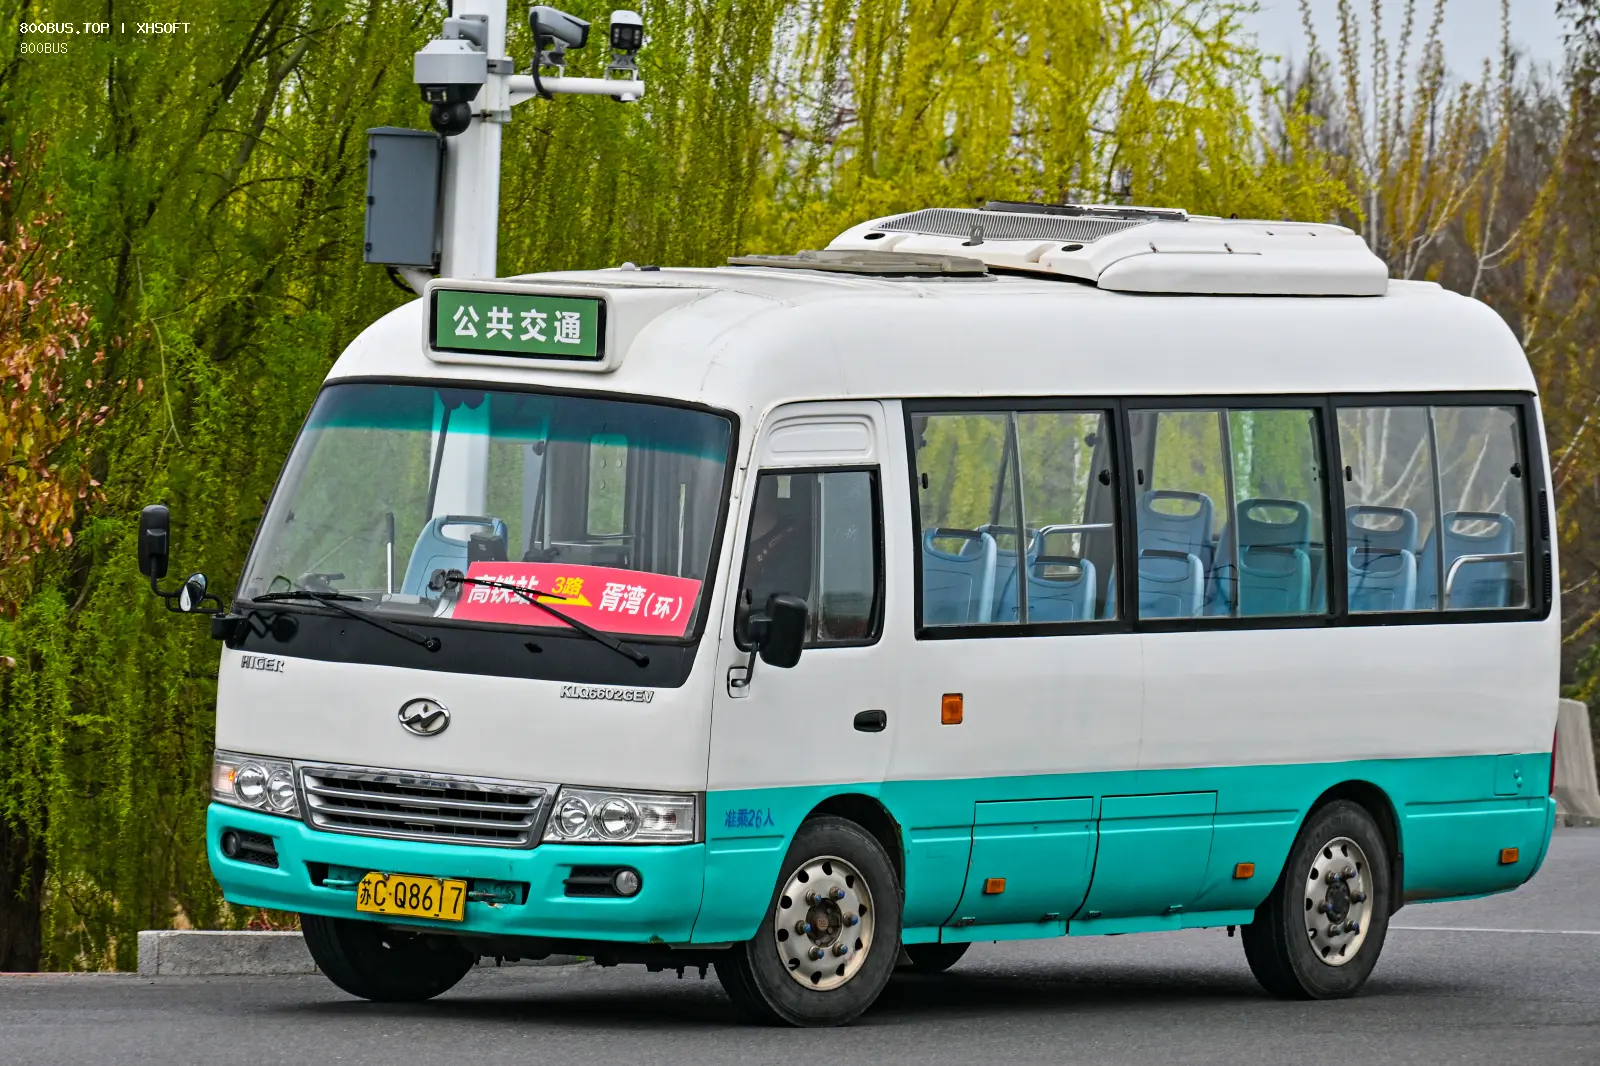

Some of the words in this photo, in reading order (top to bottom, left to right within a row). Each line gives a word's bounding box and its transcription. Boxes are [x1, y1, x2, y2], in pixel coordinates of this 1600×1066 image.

[452, 305, 581, 345] 公共交通
[467, 574, 539, 605] 高铁站
[551, 576, 584, 596] 3路
[240, 655, 285, 673] HIGER
[560, 685, 655, 703] KLQ6602GEV
[725, 807, 775, 828] 准乘26人
